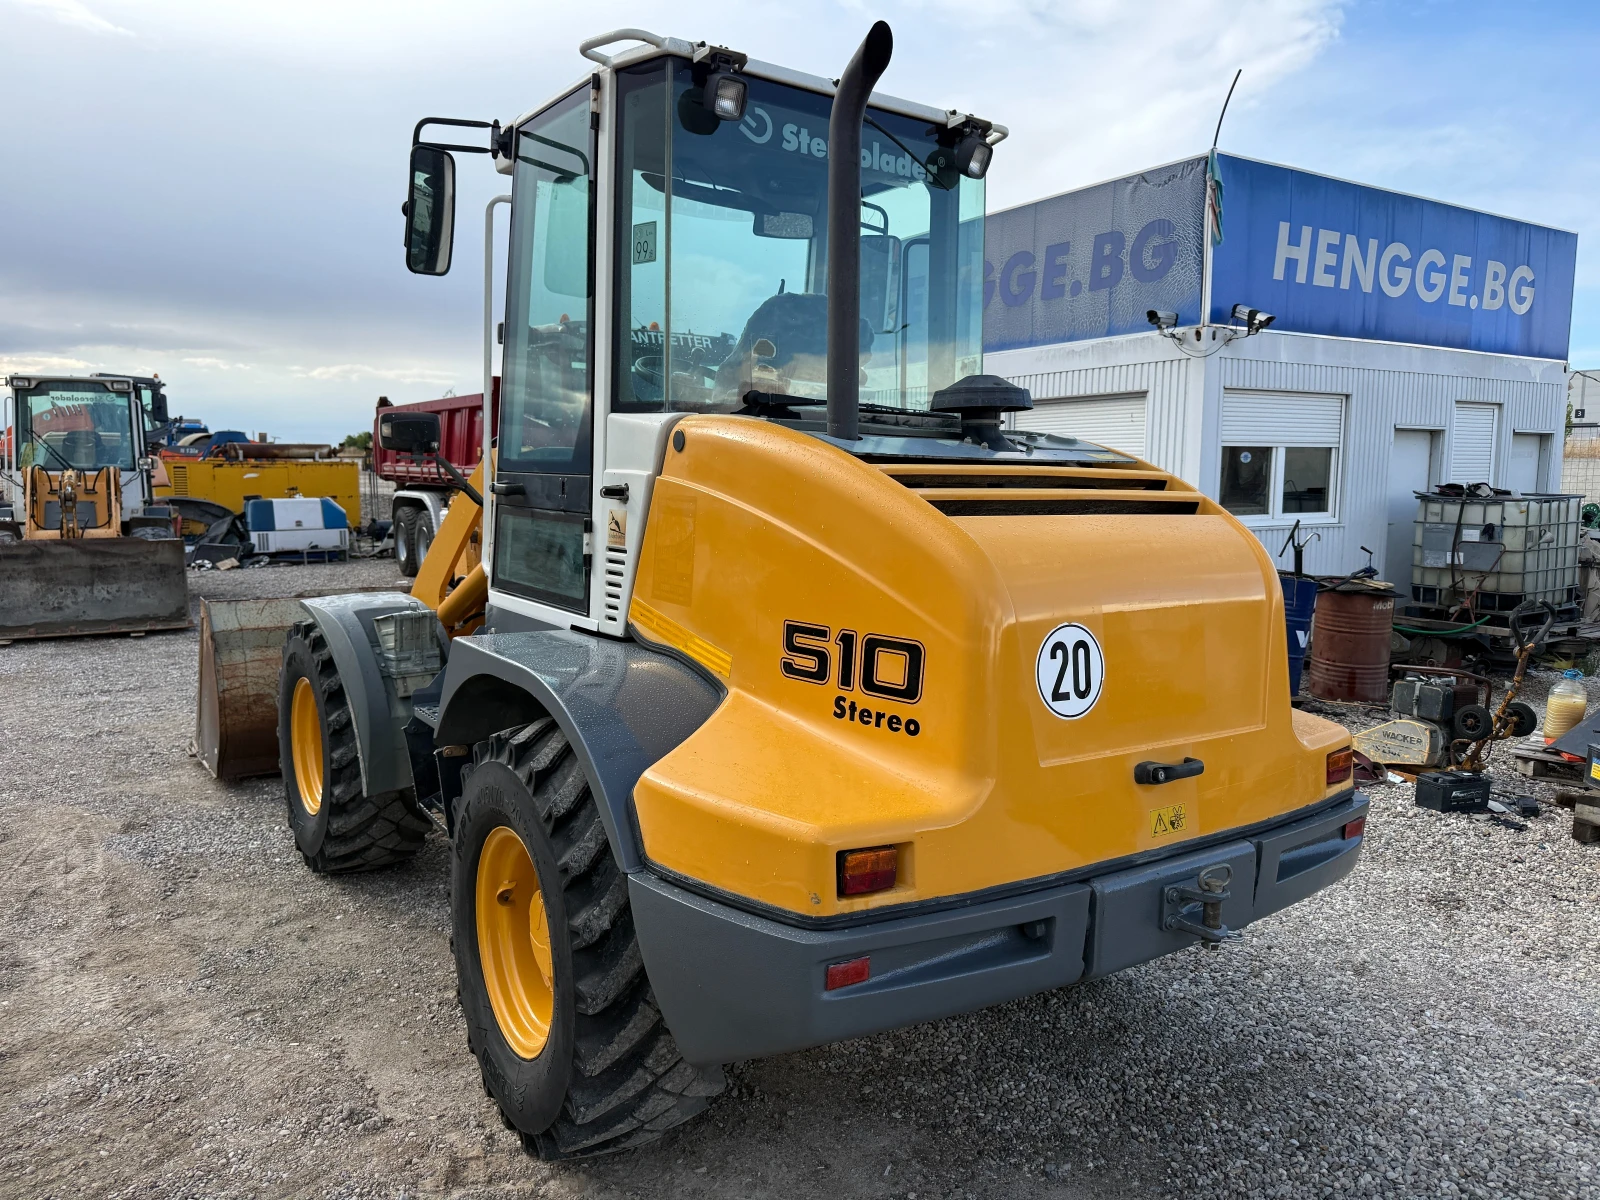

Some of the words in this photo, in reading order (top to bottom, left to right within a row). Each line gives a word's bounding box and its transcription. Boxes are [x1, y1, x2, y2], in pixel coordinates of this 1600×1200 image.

[1272, 220, 1535, 315] HENGGE.BG
[781, 619, 926, 705] 510
[1050, 640, 1092, 702] 20
[833, 695, 921, 736] Stereo
[1382, 731, 1423, 746] WACKER
